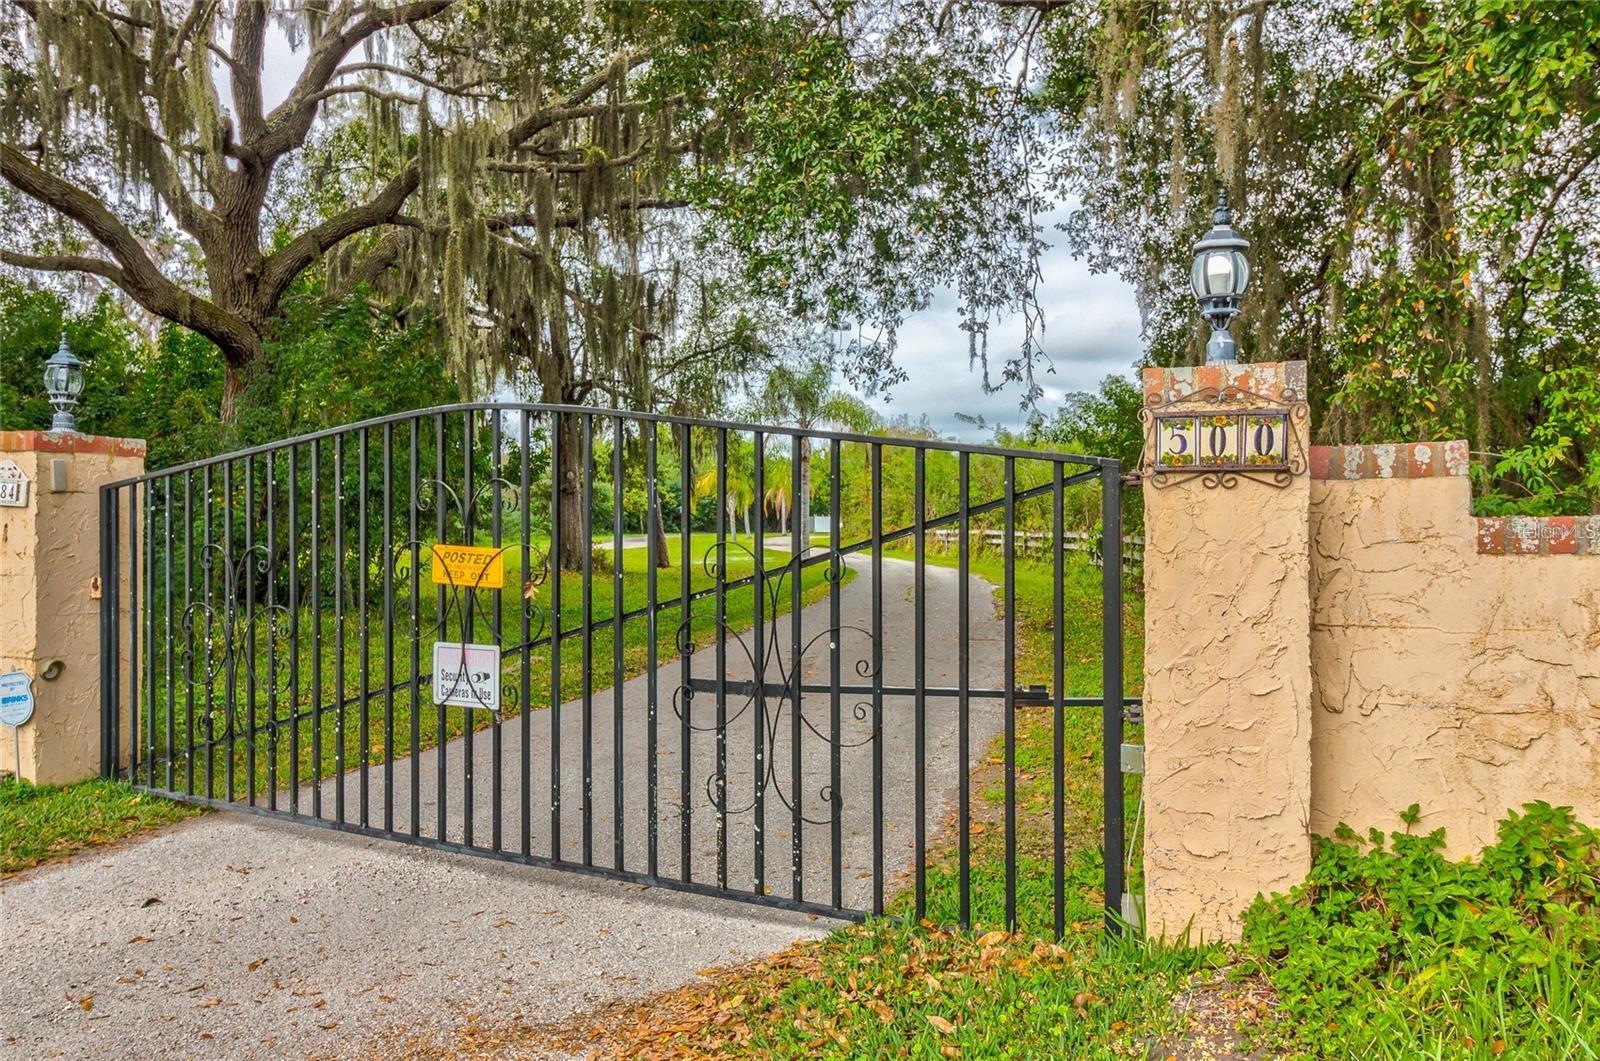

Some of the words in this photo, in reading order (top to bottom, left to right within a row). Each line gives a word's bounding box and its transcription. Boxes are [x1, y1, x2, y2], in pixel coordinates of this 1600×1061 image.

[1169, 424, 1274, 457] 500
[443, 551, 492, 565] POSTED
[441, 668, 469, 685] Secuity
[479, 687, 492, 700] Use
